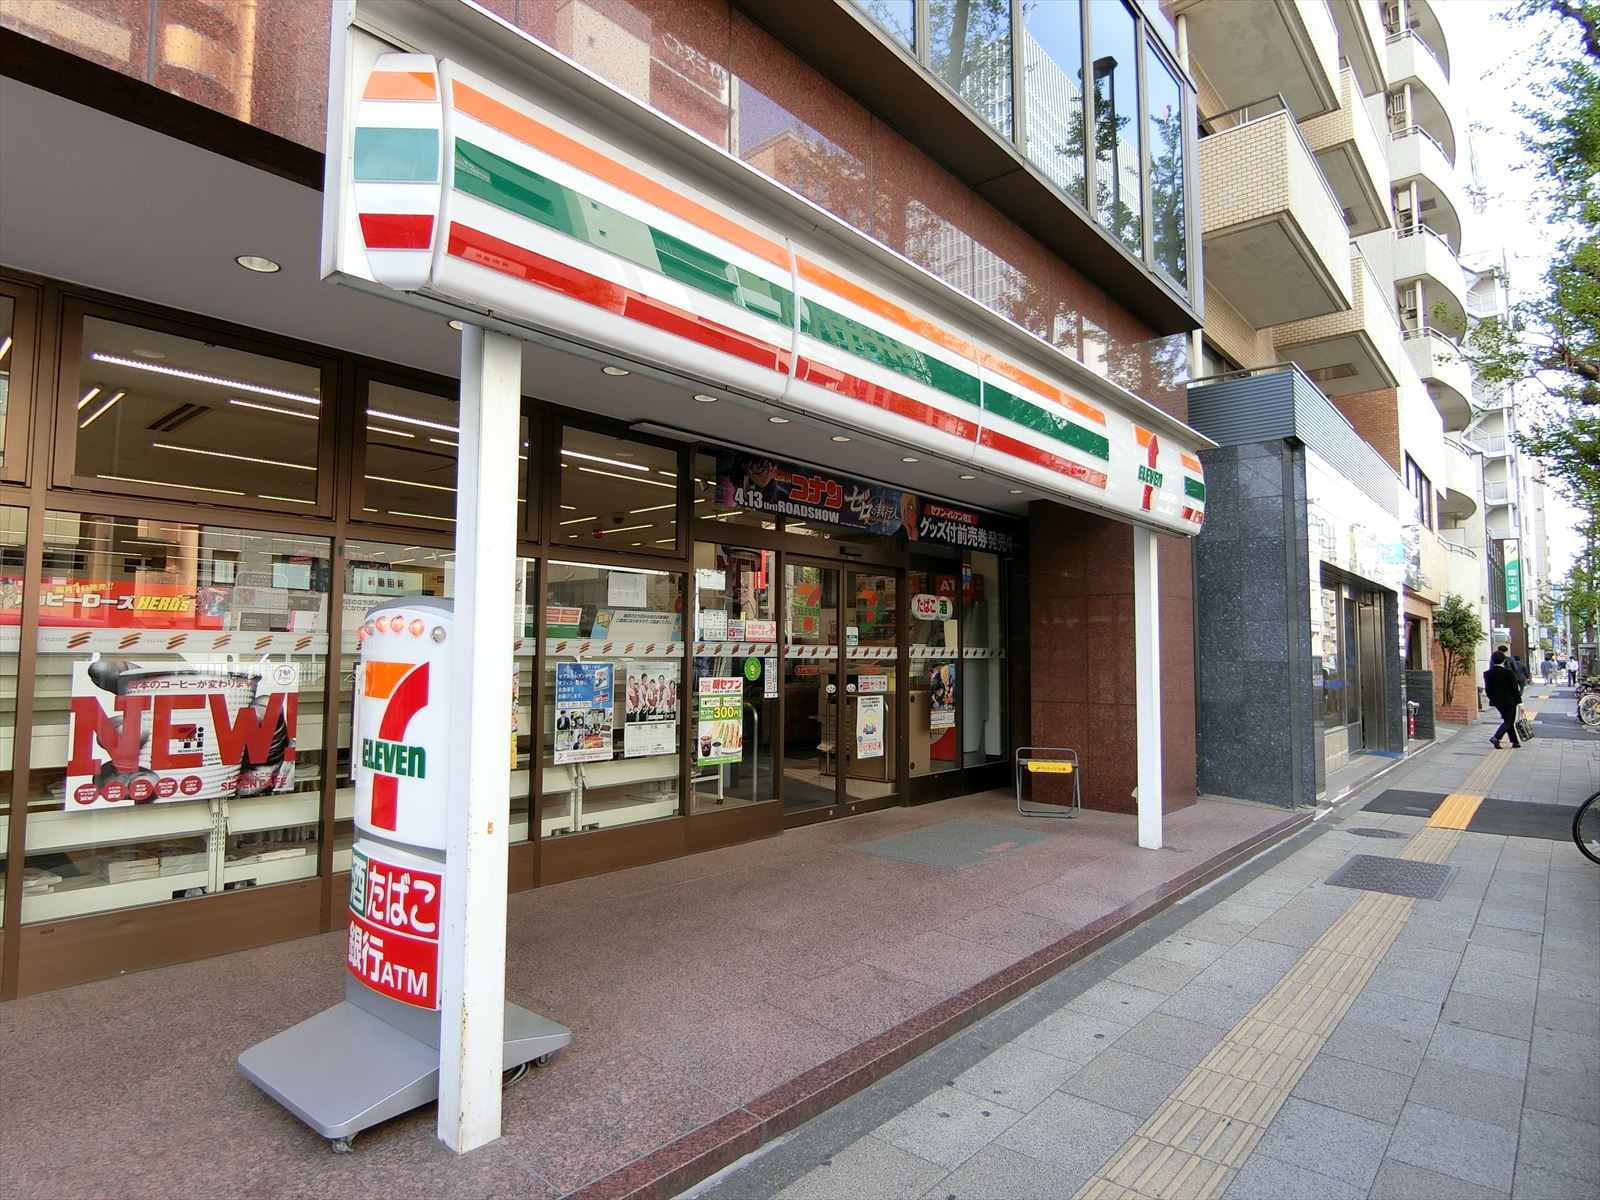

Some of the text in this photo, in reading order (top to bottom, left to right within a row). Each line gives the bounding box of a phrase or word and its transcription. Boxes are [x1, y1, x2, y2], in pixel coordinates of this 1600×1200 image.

[734, 487, 762, 509] 4.13
[778, 500, 840, 524] ROADSHOW
[788, 474, 843, 509] コナン
[916, 598, 948, 614] たばこ 酒
[712, 679, 742, 690] 朝セブン
[68, 692, 299, 776] NEW!
[221, 780, 256, 791] SEVEN
[368, 865, 436, 932] たばこ
